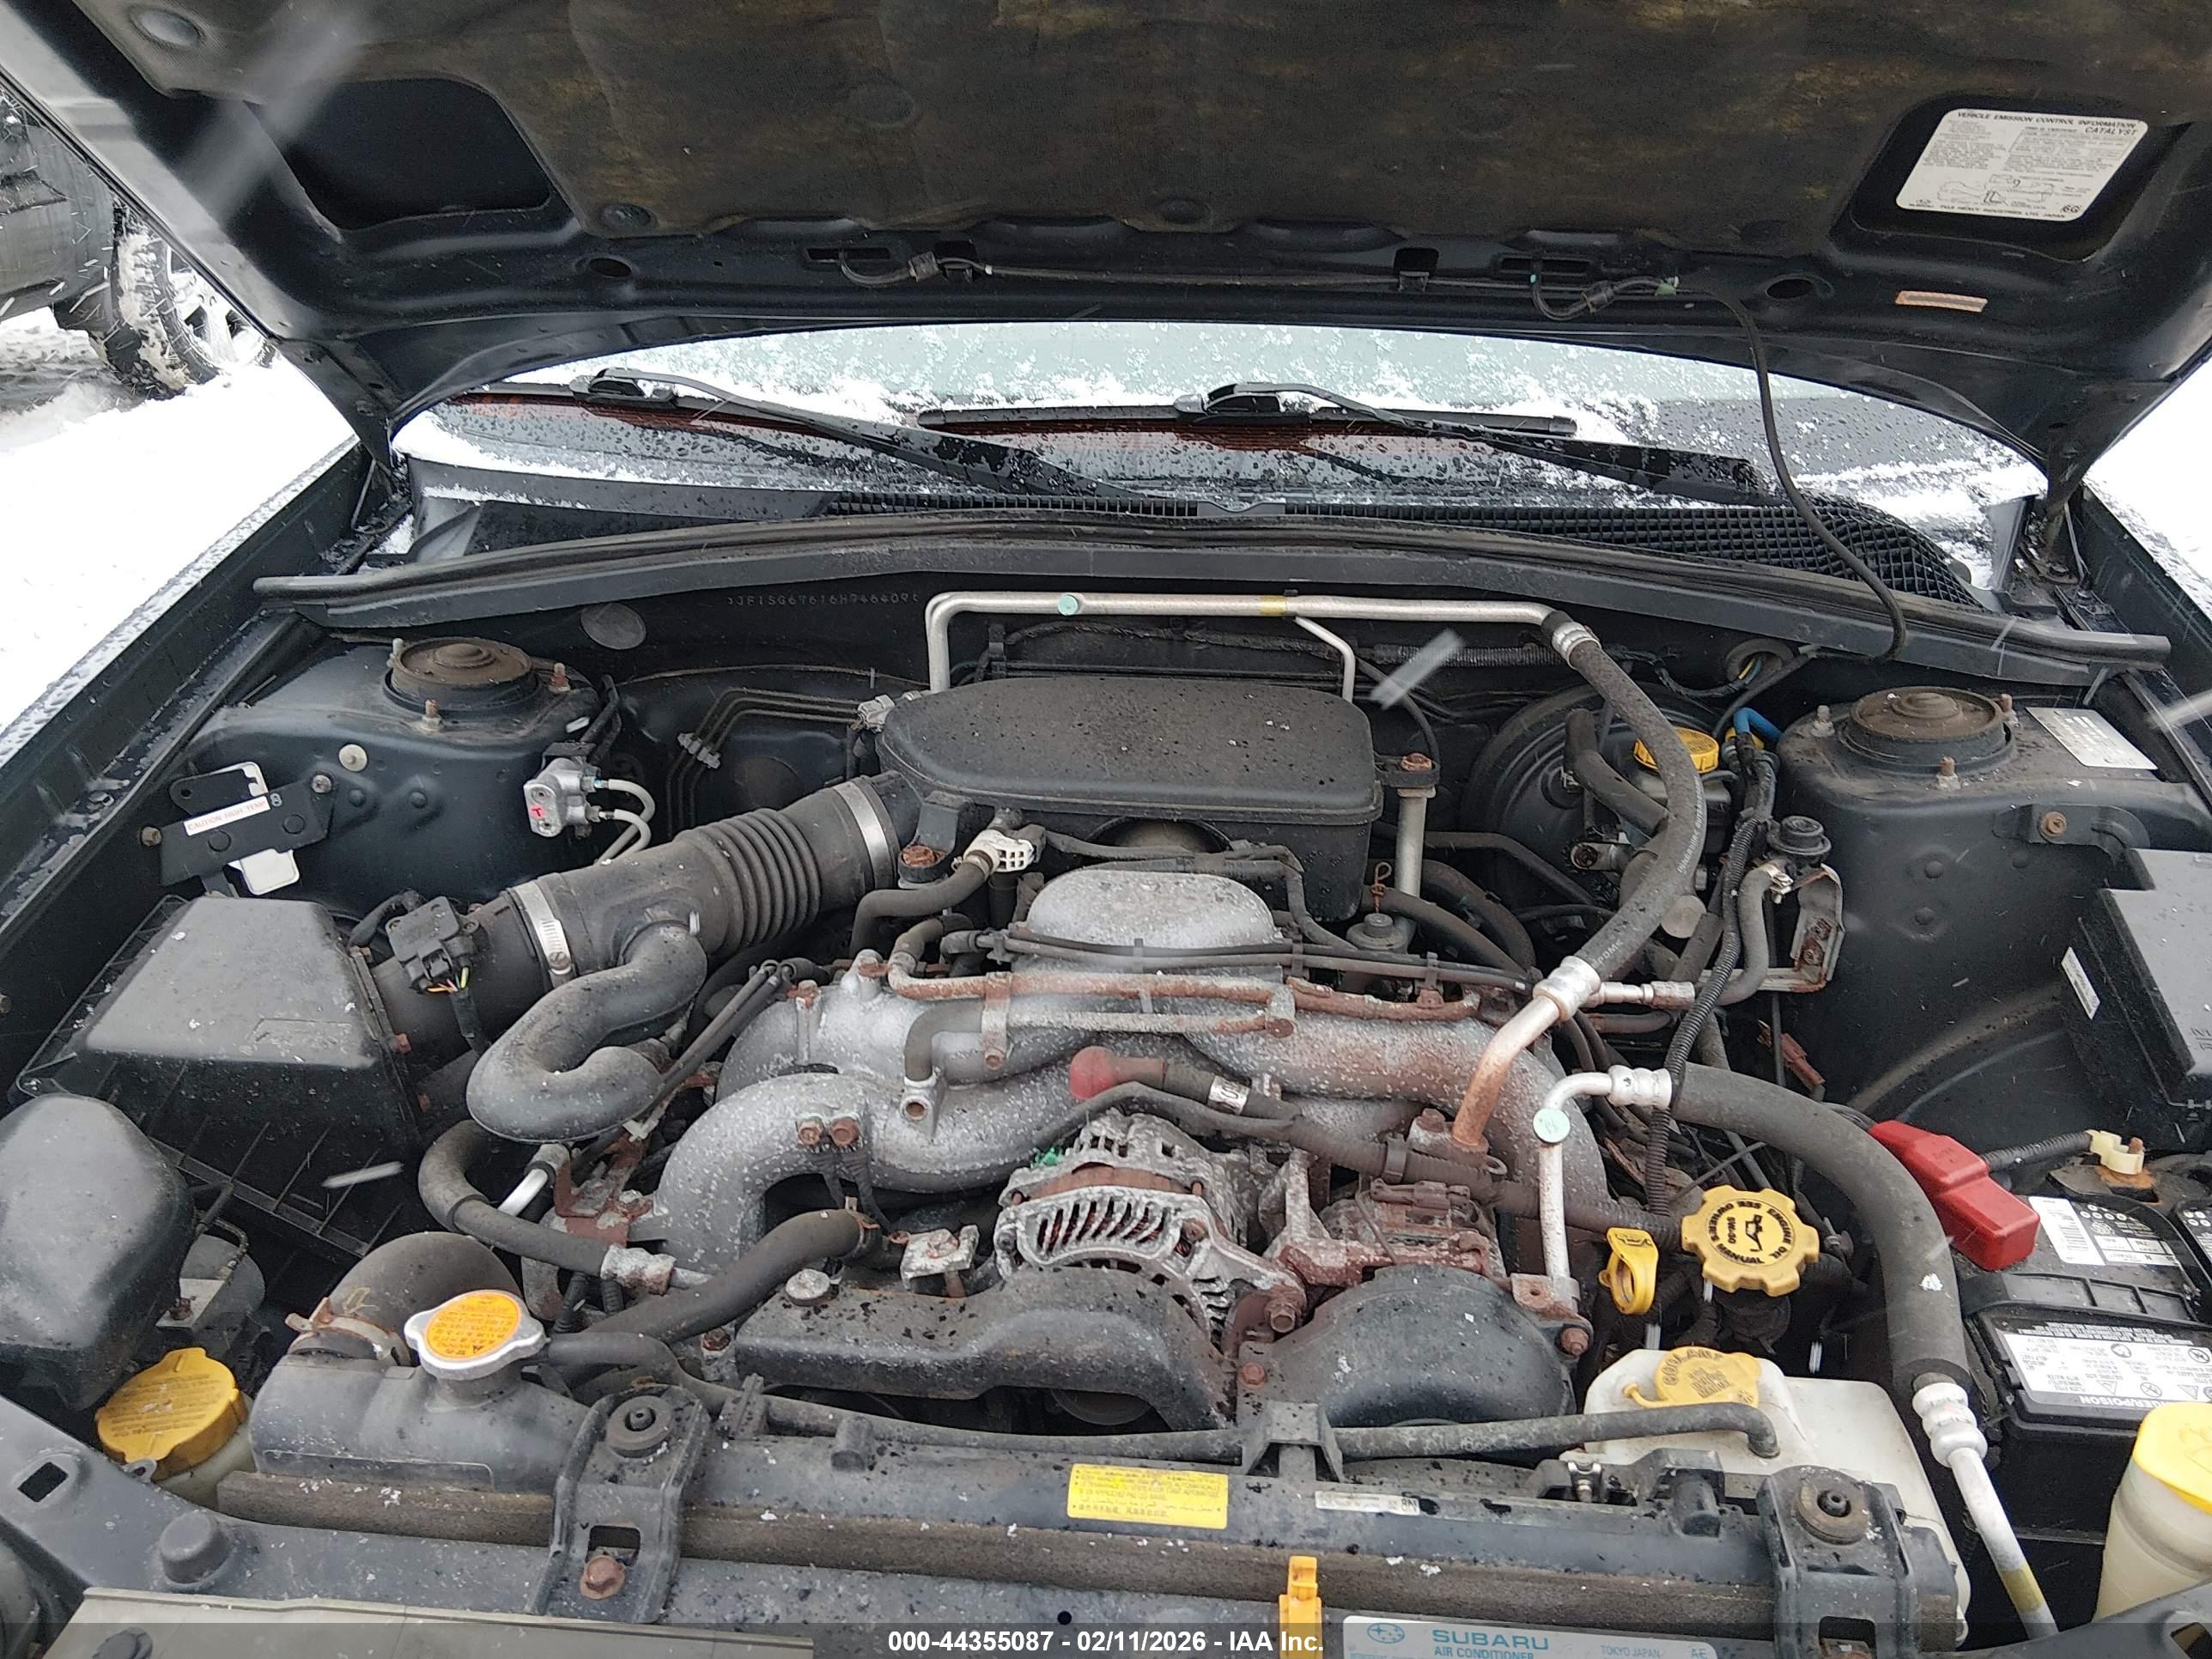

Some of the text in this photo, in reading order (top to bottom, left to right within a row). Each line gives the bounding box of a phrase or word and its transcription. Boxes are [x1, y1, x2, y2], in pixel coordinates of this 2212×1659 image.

[1993, 114, 2033, 123] EMISSION
[2035, 117, 2075, 125] CONTROL
[2077, 119, 2137, 129] INFORMATION
[2085, 126, 2138, 136] CATALYST
[188, 816, 222, 831] CAUTION
[1736, 1200, 1762, 1209] SEE
[1726, 1216, 1736, 1244] 5W-30
[1766, 1208, 1792, 1259] ENGINE OIL
[1717, 1243, 1765, 1264] MANUAL
[1662, 1348, 1724, 1386] COOLANT
[1432, 1629, 1549, 1650] SUBARU
[1434, 1646, 1454, 1658] AIR
[1456, 1647, 1534, 1659] CONDITIONER
